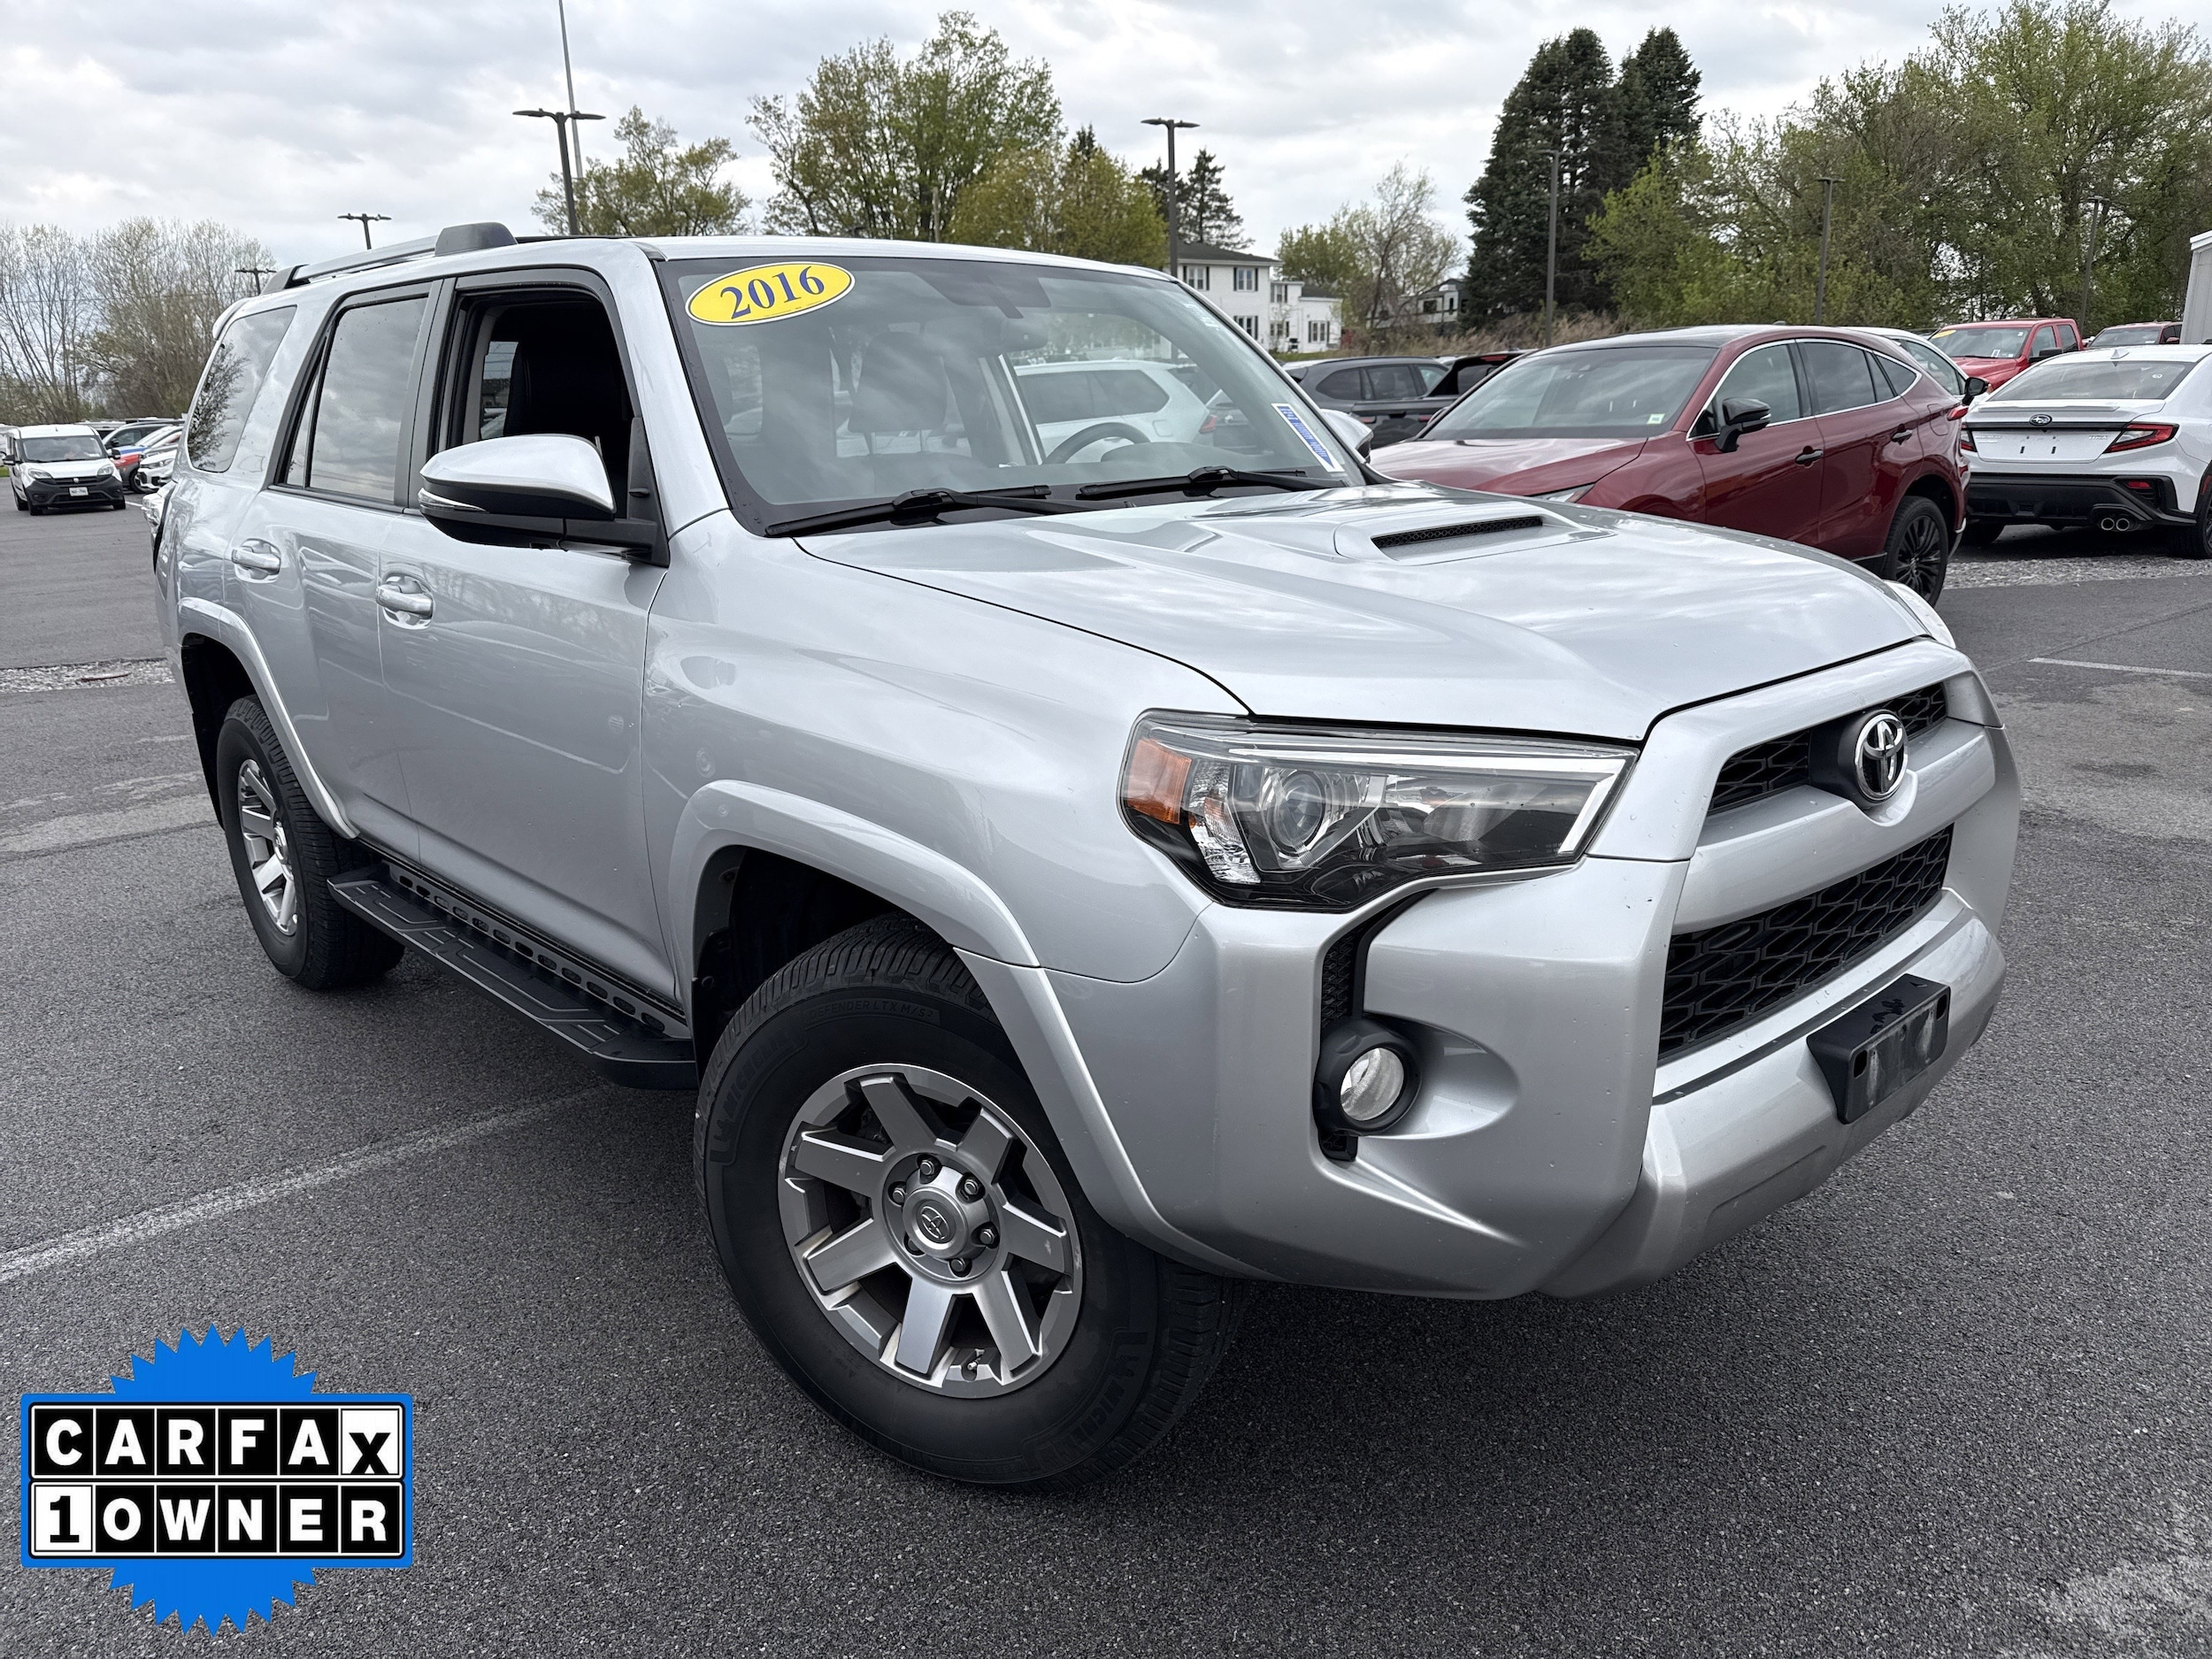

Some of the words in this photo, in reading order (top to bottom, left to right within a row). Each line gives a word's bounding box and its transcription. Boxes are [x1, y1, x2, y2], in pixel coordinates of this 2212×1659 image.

[720, 265, 826, 319] 2016
[809, 1001, 870, 1020] DEFENDER
[873, 1001, 897, 1012] LTX
[724, 1029, 791, 1118] MICHELIN
